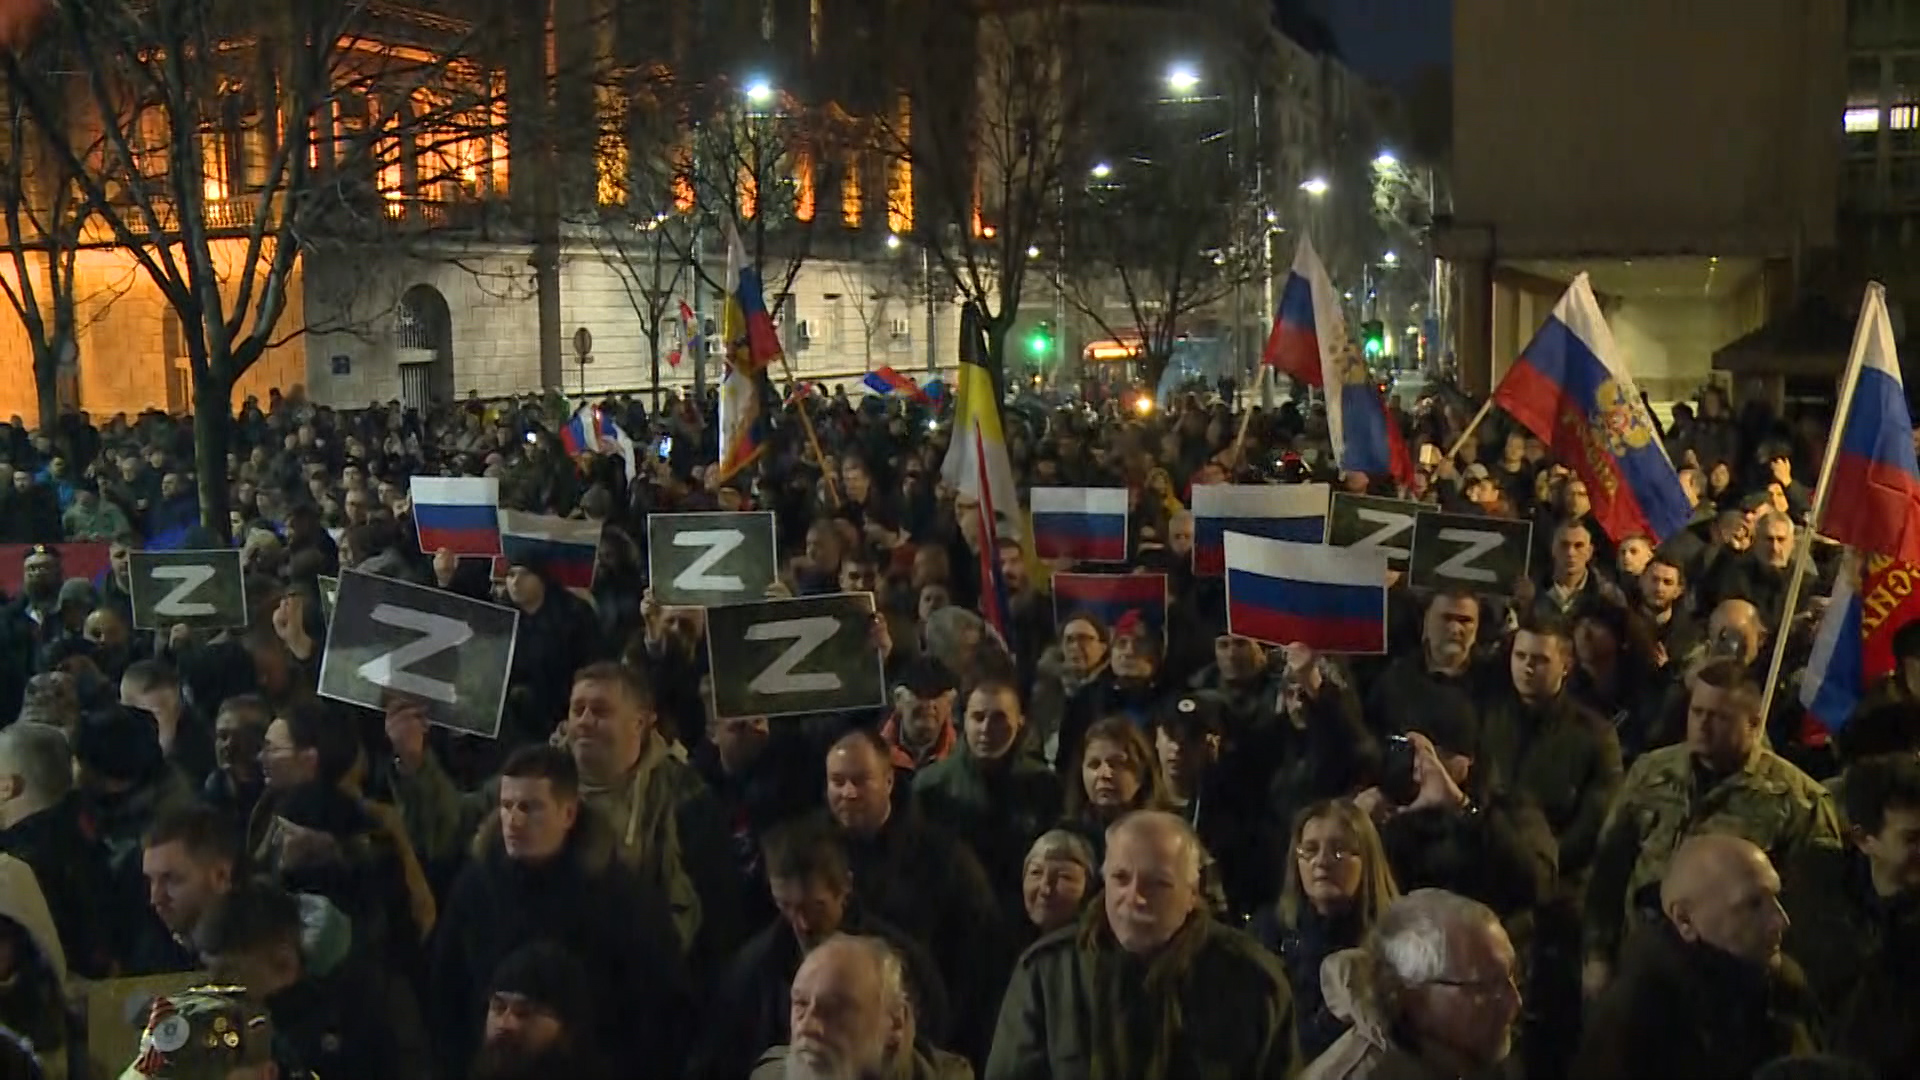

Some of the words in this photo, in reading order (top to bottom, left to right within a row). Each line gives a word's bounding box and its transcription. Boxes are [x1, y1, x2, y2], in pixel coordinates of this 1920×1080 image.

[672, 529, 745, 590] Z
[1357, 507, 1415, 560] Z
[1434, 527, 1505, 582] Z
[151, 564, 216, 616] Z
[357, 603, 474, 704] Z
[743, 615, 842, 694] Z
